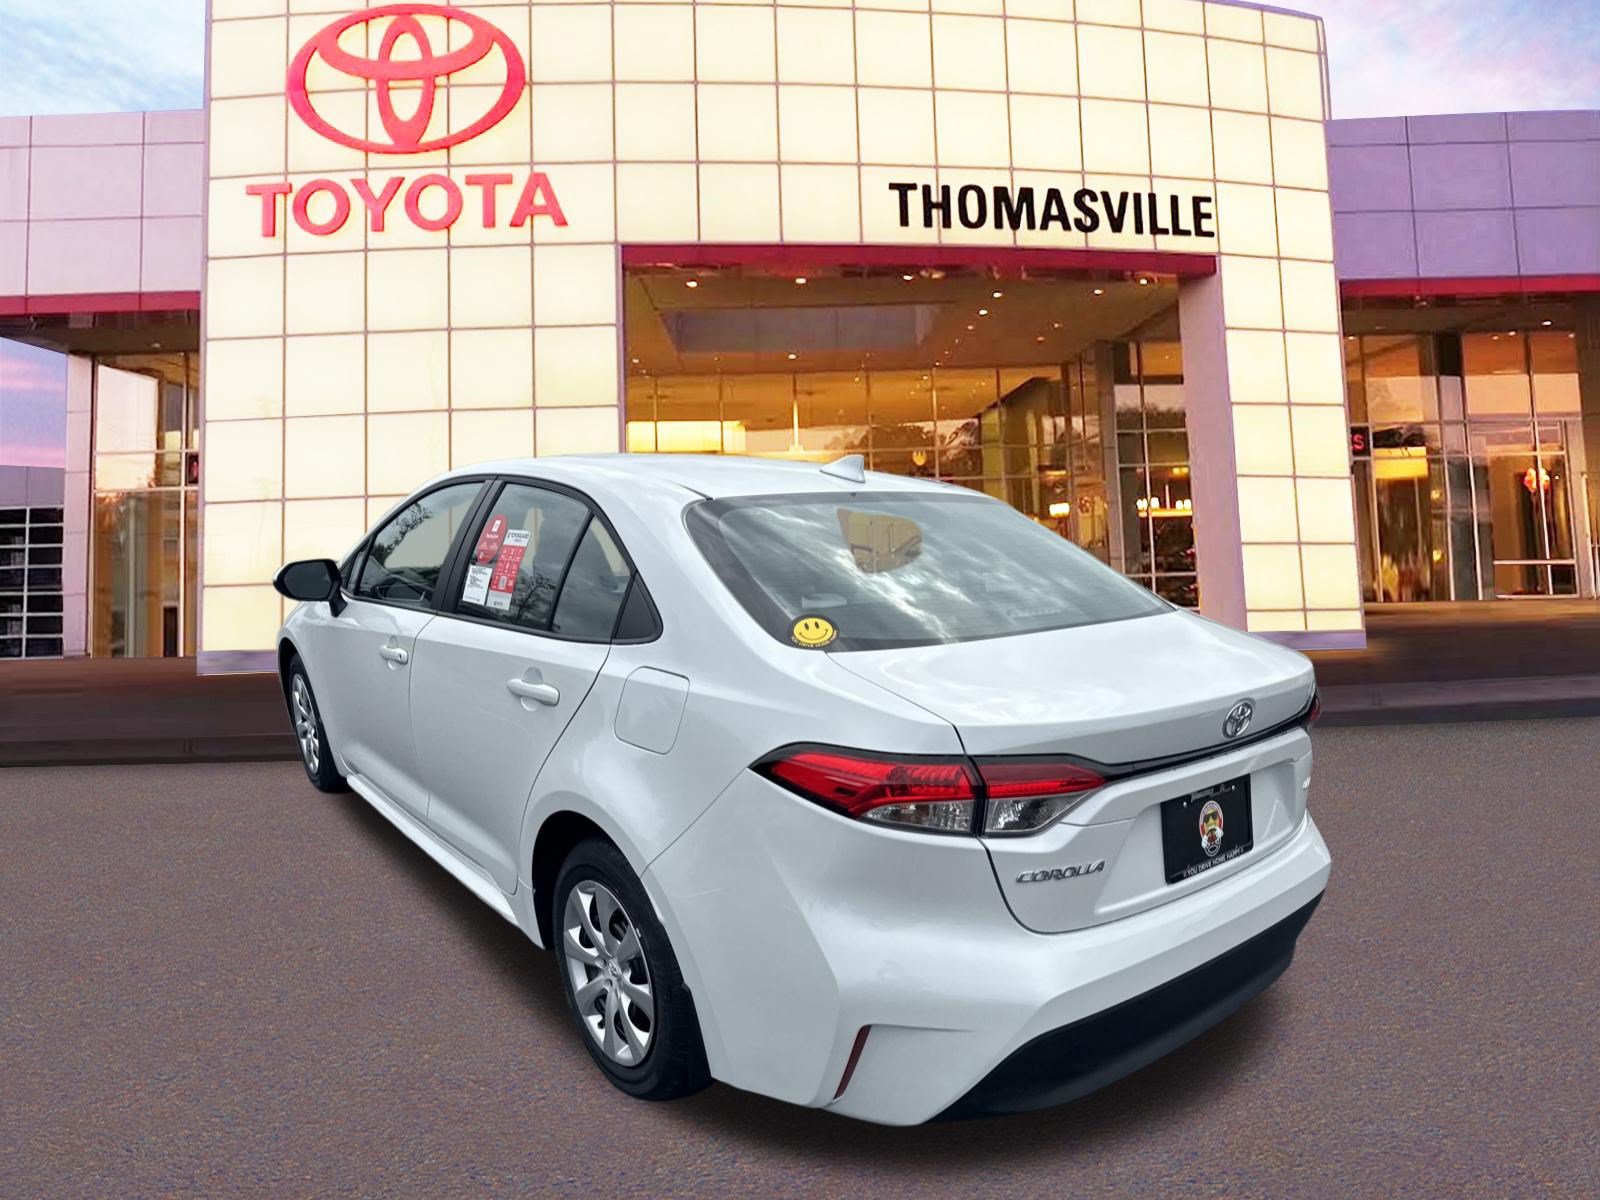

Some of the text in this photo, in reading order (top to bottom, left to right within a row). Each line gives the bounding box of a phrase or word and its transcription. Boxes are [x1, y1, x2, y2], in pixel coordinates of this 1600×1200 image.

[246, 172, 568, 237] TOYOTA
[889, 182, 1215, 237] THOMASVILLE
[1015, 859, 1105, 883] COROLLA
